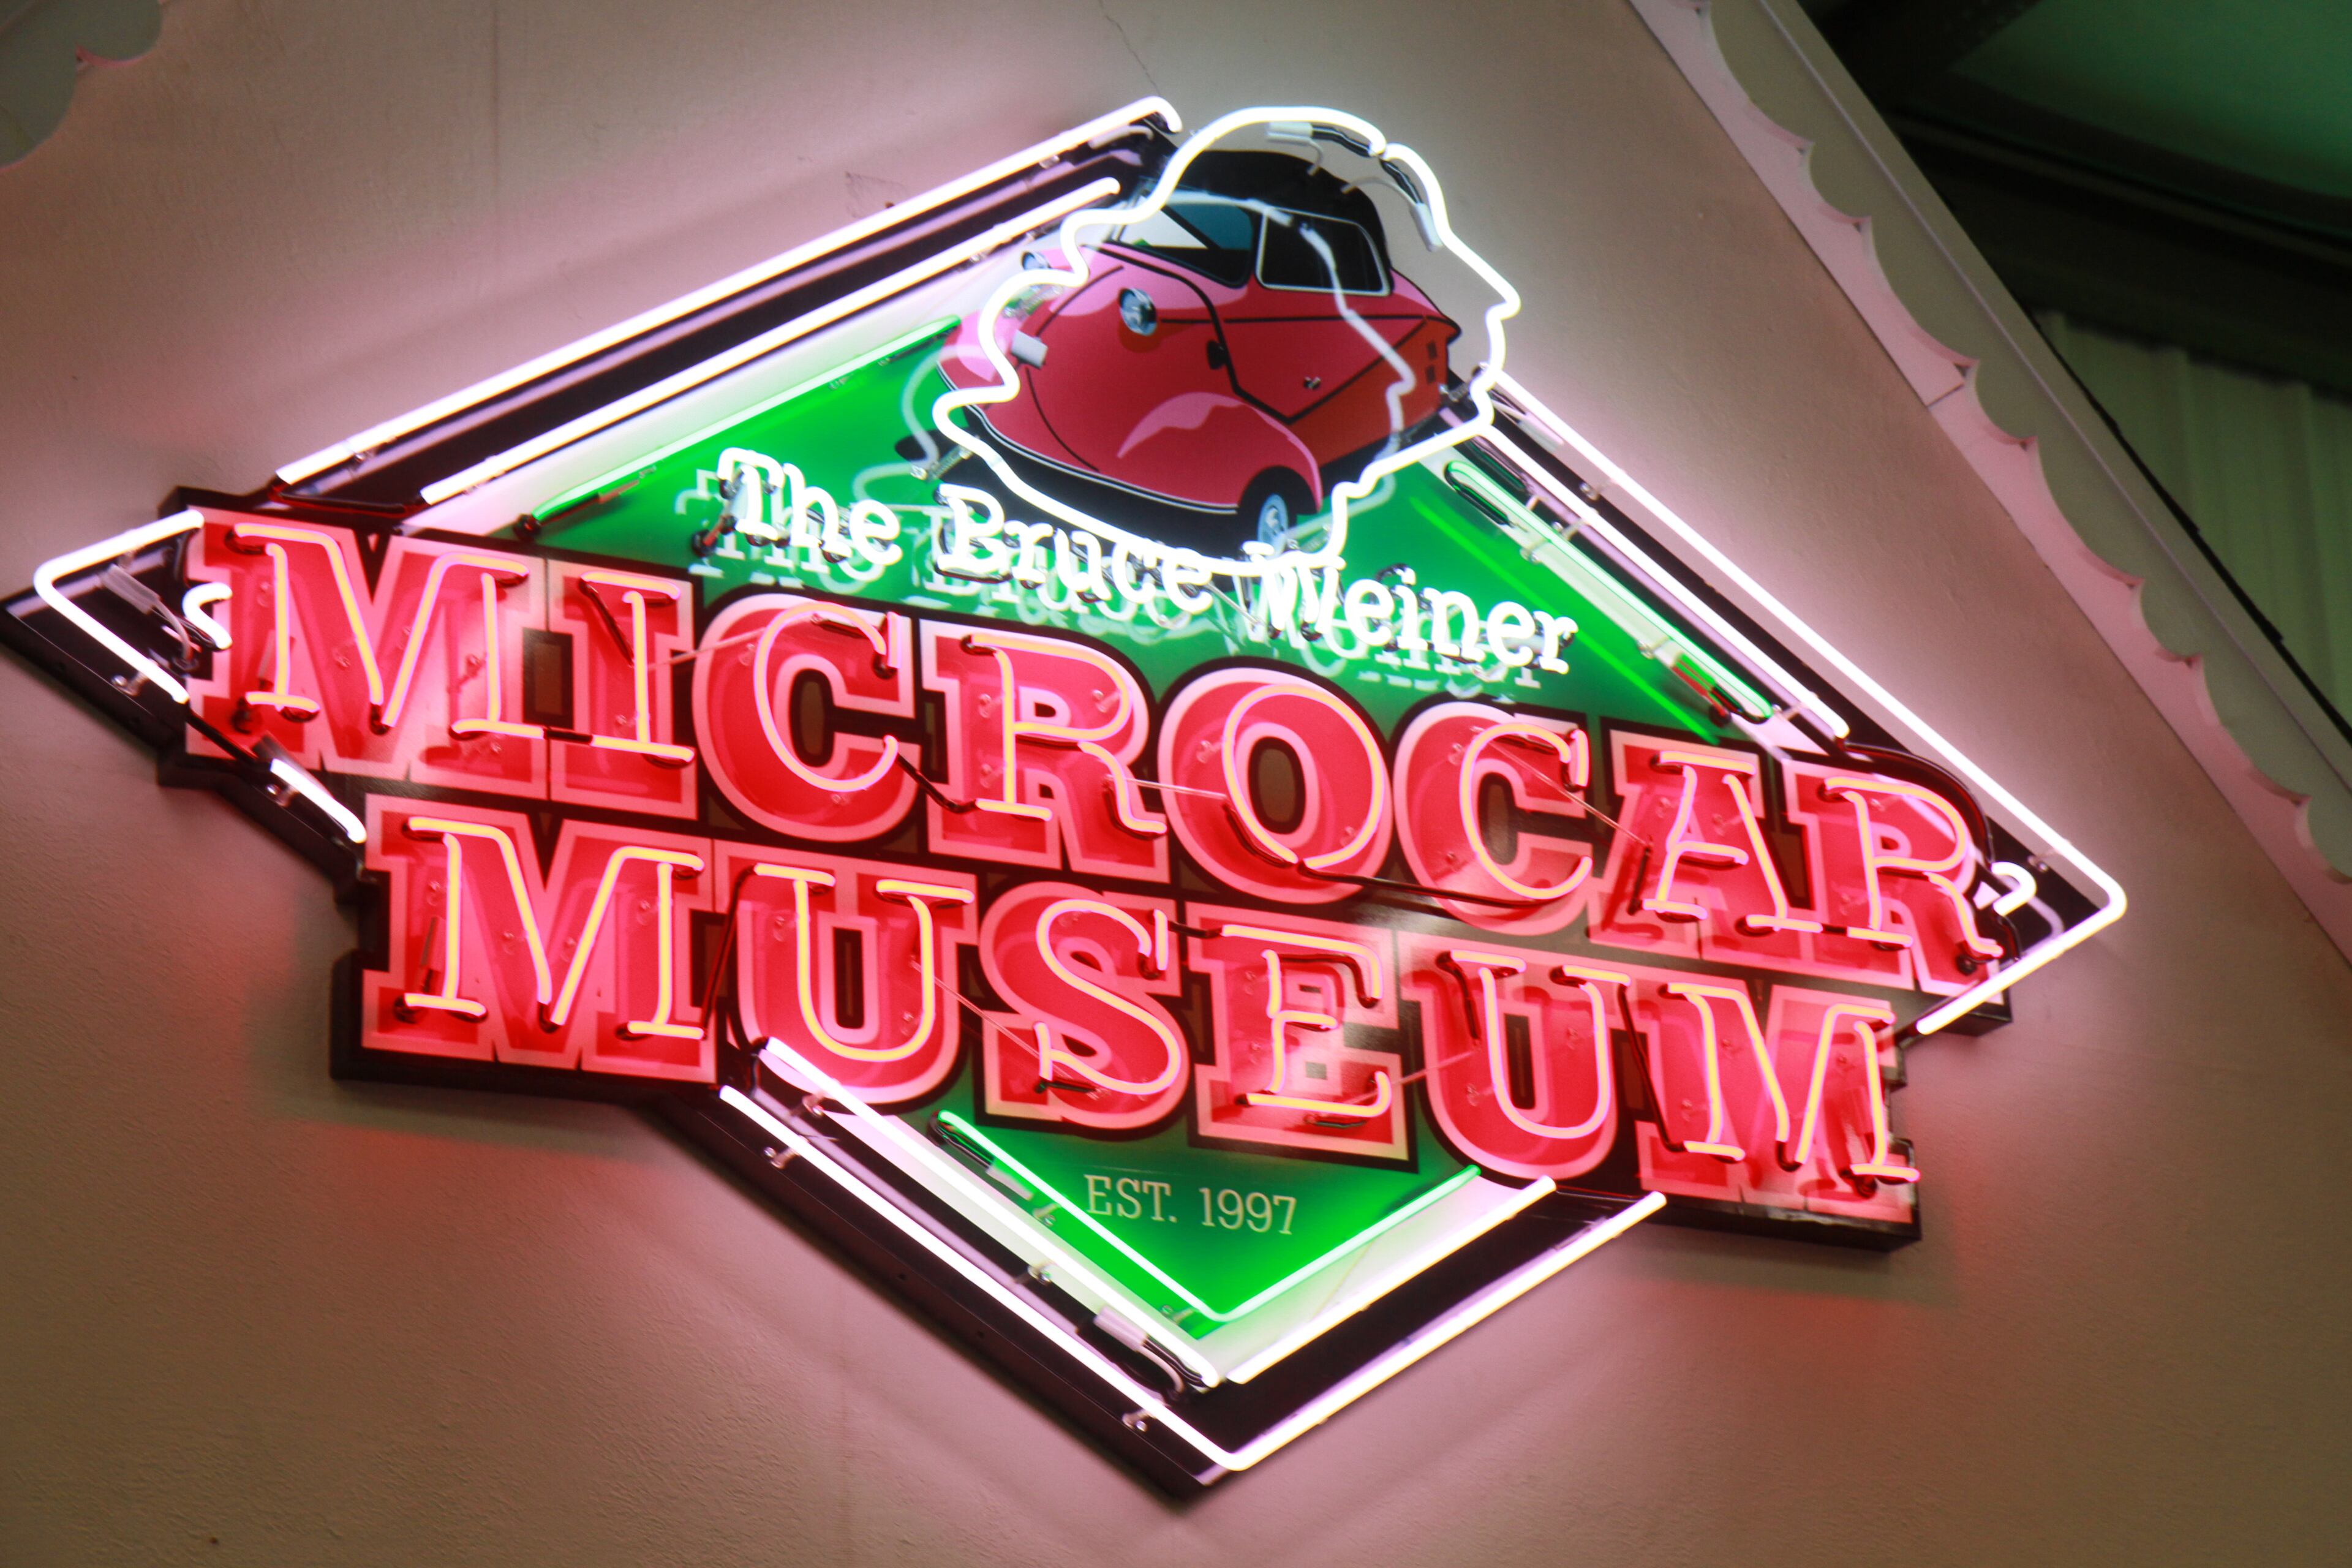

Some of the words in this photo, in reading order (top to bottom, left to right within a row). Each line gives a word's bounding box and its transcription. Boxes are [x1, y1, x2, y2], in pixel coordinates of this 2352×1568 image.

[718, 447, 902, 565] The
[937, 483, 1213, 613] Bruce
[1241, 540, 1578, 674] Weiner
[187, 505, 2004, 1005] MICROCAR
[362, 793, 1920, 1223] MUSEUM
[1084, 1174, 1177, 1223] EST.
[1199, 1187, 1297, 1235] 1997
